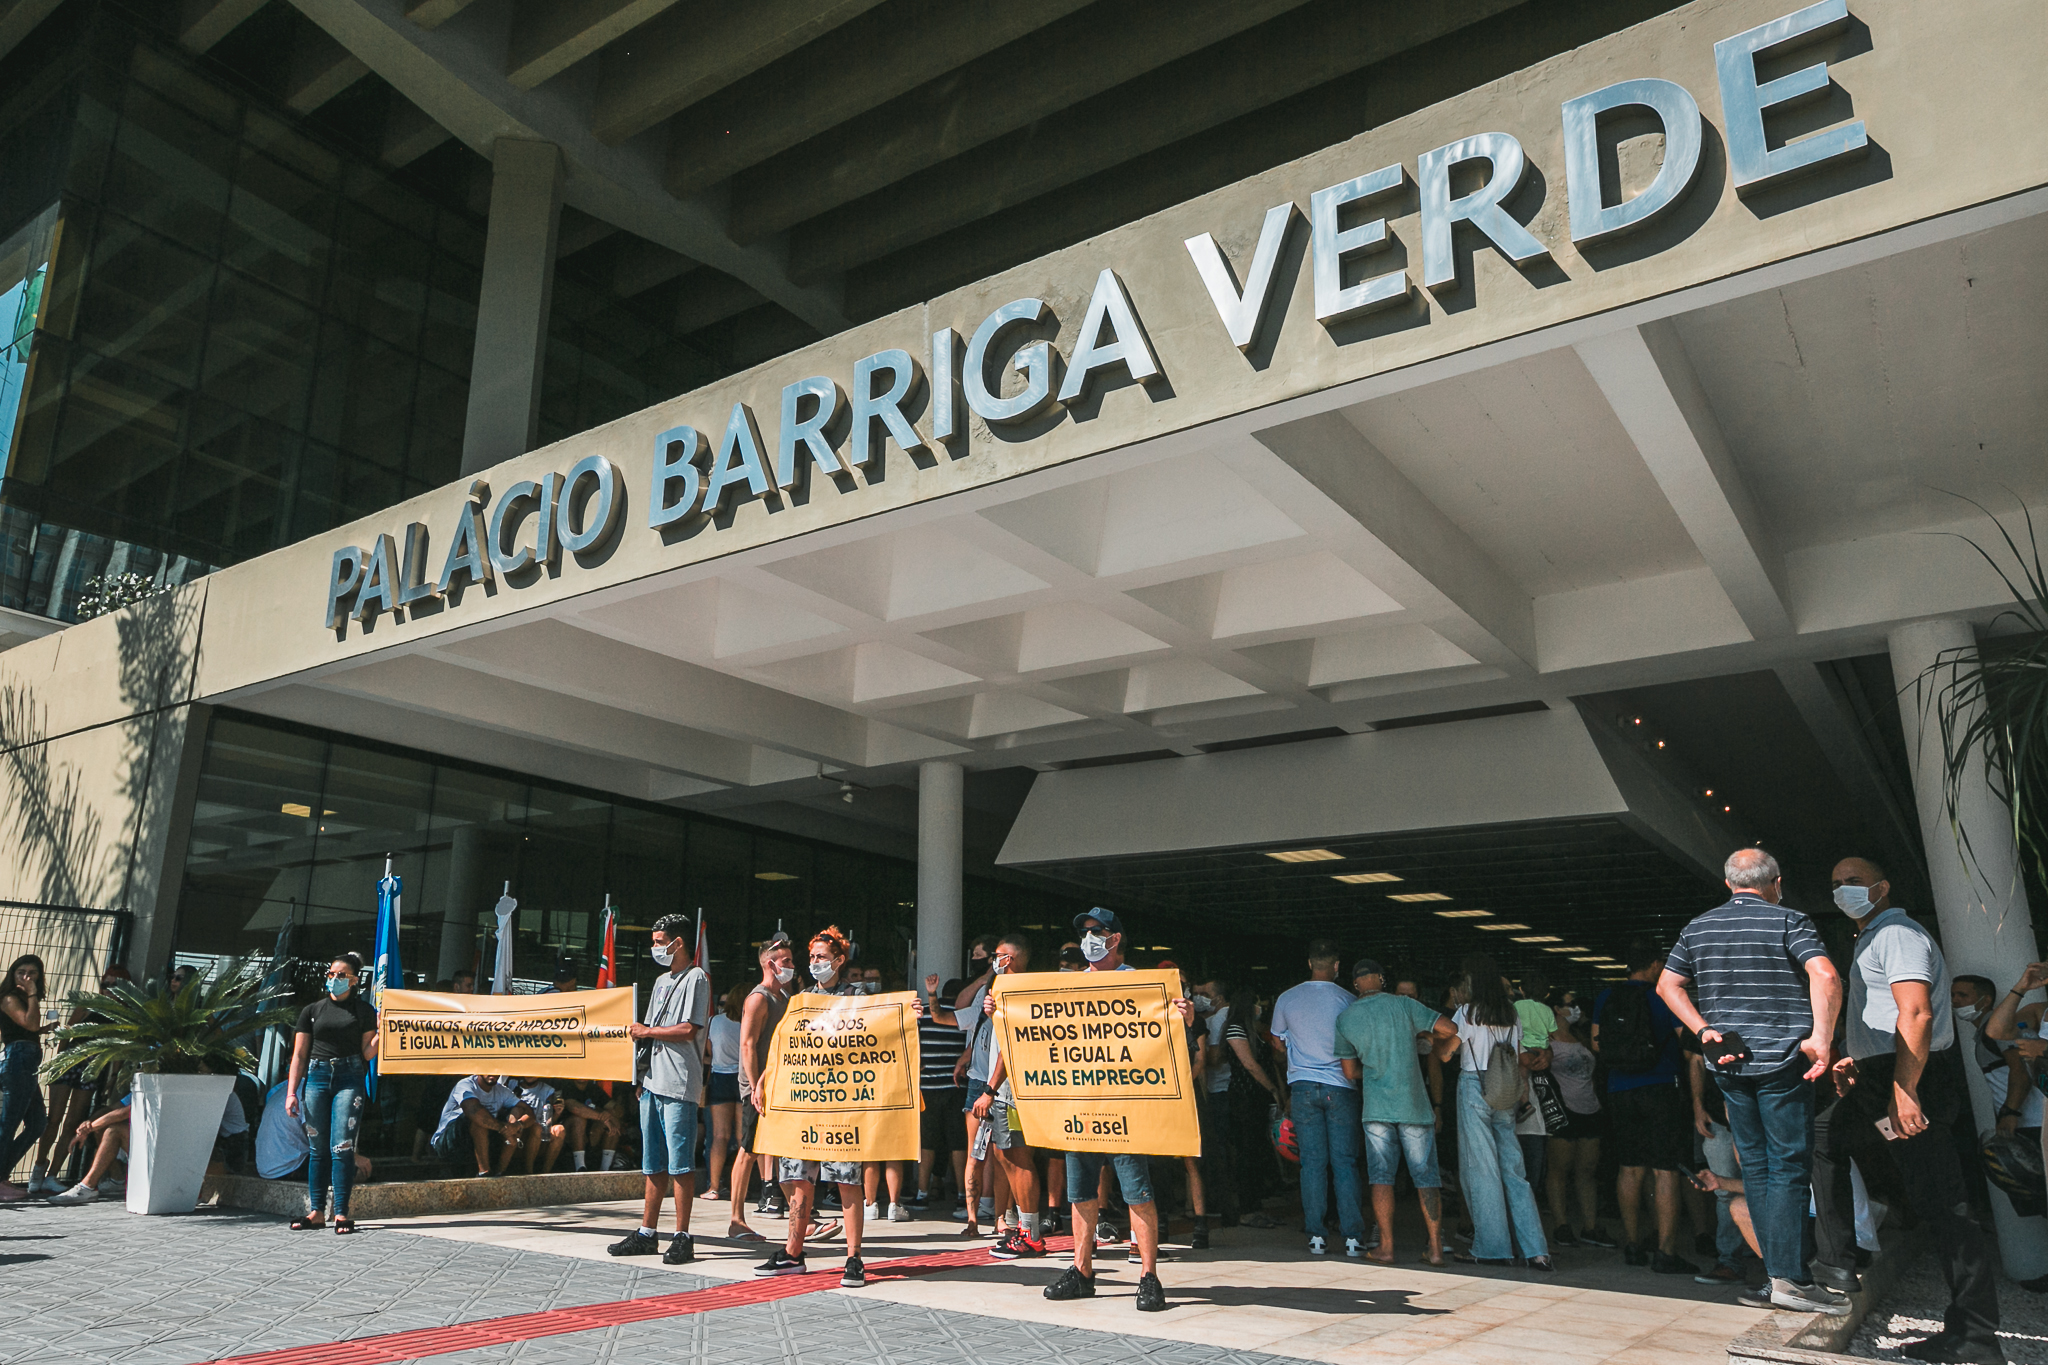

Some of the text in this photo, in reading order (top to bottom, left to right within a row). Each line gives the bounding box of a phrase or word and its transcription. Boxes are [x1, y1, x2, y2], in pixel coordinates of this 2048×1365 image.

[325, 0, 1869, 630] PALÁCIO BARRIGA VERDE
[1030, 998, 1142, 1019] DEPUTADOS,
[389, 1016, 579, 1034] DEPUTADOS, MENOS IMPOSTO
[1015, 1020, 1162, 1042] MENOS IMPOSTO
[400, 1032, 567, 1050] É IGUAL A MAIS EMPREGO.
[789, 1033, 878, 1049] EU NÃO QUERO
[783, 1050, 897, 1066] PAGAR MAIS CARO!
[1049, 1043, 1133, 1063] É IGUAL A
[790, 1068, 876, 1088] REDUÇÃO DO
[1024, 1067, 1167, 1086] MAIS EMPREGO!
[790, 1085, 875, 1102] IMPOSTO JÁ!
[1064, 1114, 1128, 1135] abrasel
[801, 1126, 859, 1145] abrasel
